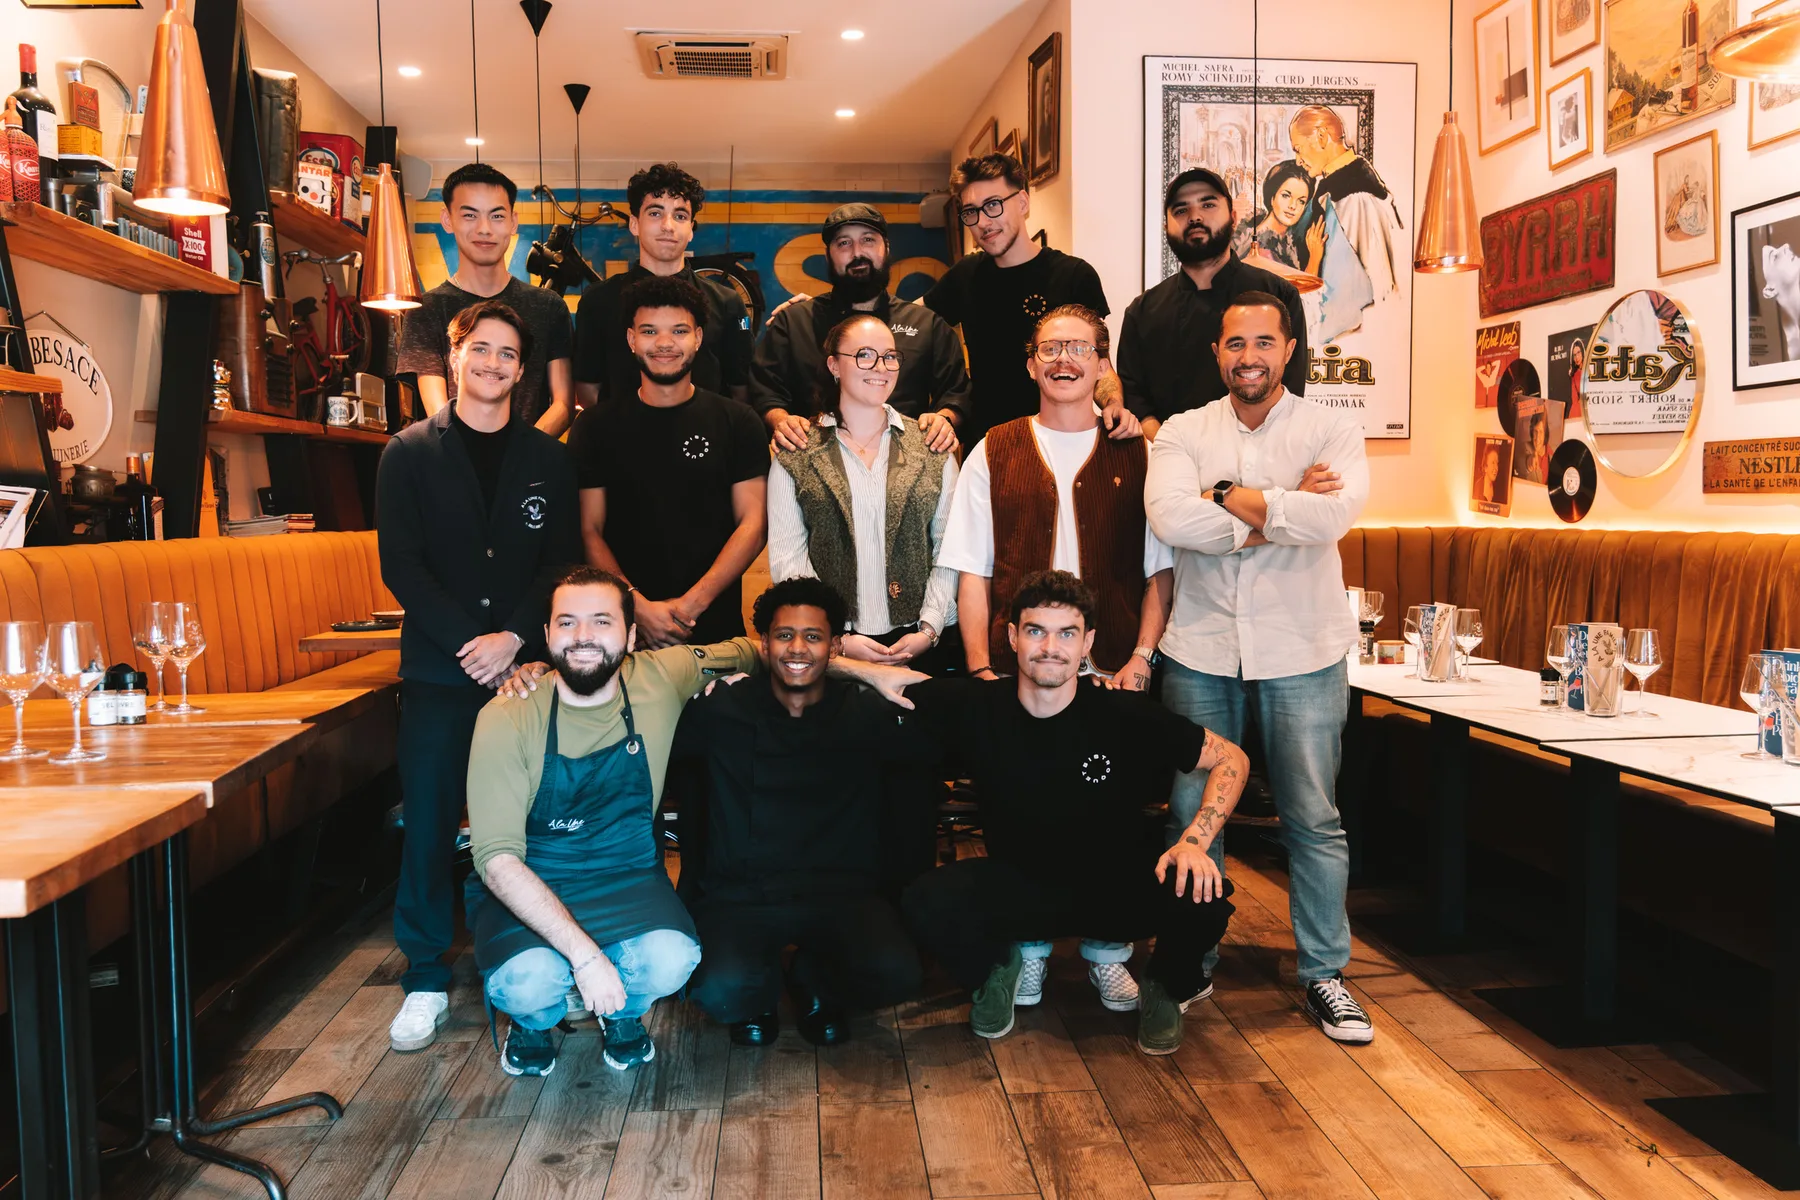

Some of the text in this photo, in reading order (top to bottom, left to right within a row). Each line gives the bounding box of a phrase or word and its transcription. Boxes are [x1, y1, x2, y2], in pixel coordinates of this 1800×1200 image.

[1163, 63, 1199, 71] MICHEL
[1204, 64, 1234, 72] SAFRA
[1162, 73, 1192, 82] ROMY
[1199, 74, 1261, 83] SCHNEIDER
[1275, 75, 1304, 84] CURD
[1708, 72, 1722, 89] SUZ
[299, 165, 331, 177] NTAR
[184, 227, 202, 238] Shell
[1484, 185, 1608, 293] BYRRH
[30, 336, 100, 396] BESACE
[1711, 445, 1730, 456] LAIT
[1710, 480, 1720, 489] LA
[1723, 477, 1751, 488] SANTÉ
[1769, 478, 1800, 488] L'ENFA
[1592, 632, 1603, 645] UNE
